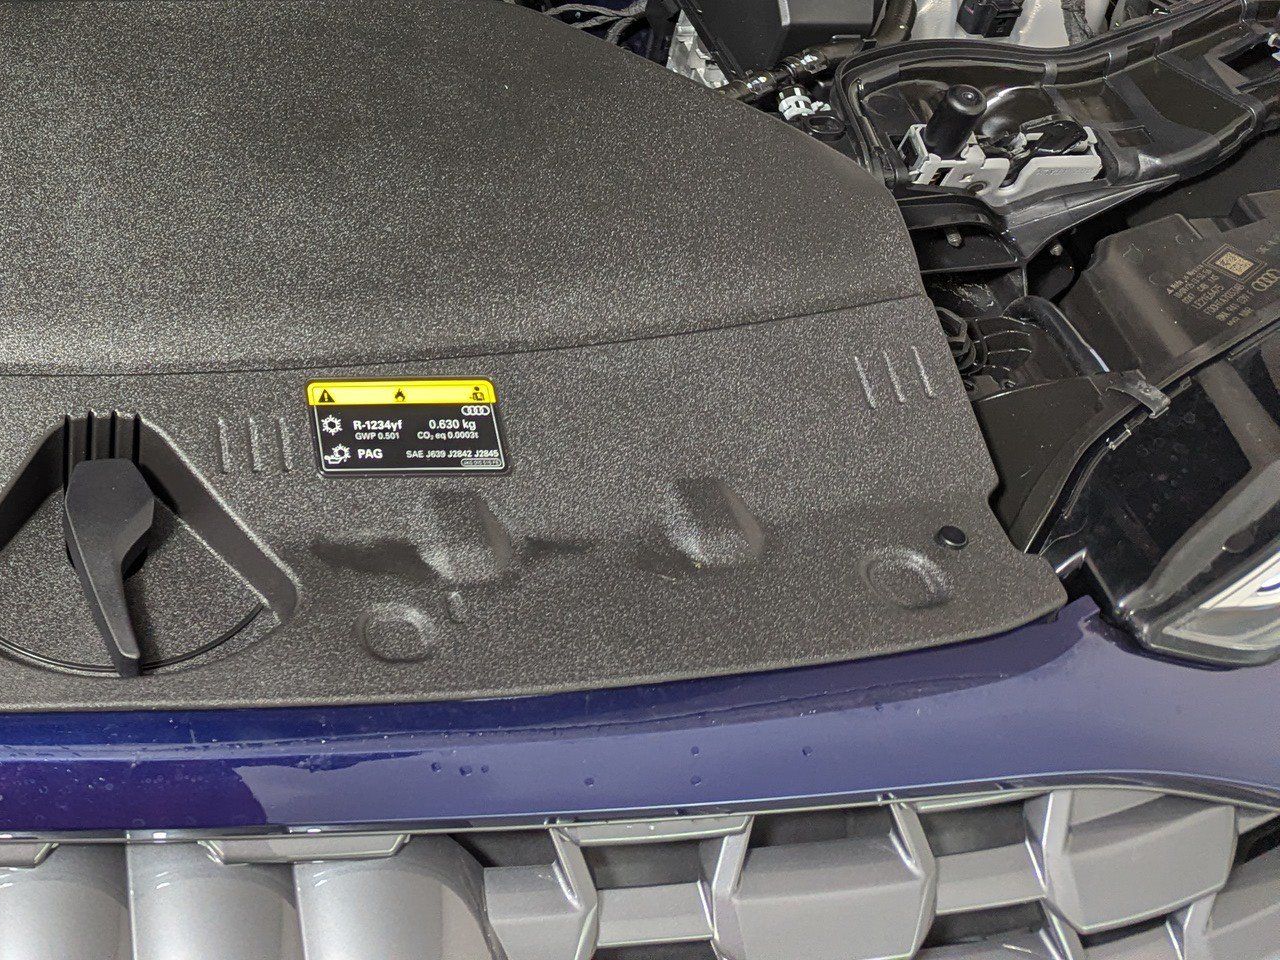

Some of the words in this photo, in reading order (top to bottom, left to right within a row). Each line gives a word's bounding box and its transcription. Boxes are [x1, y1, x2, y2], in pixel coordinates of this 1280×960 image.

[352, 420, 402, 431] R-1234yf
[428, 420, 460, 429] 0.630
[462, 419, 477, 430] kg
[378, 432, 400, 440] 0.501
[357, 448, 383, 459] PAG
[406, 450, 424, 458] SAE
[425, 450, 446, 458] J639
[447, 450, 472, 458] J2842
[474, 450, 500, 458] J2845
